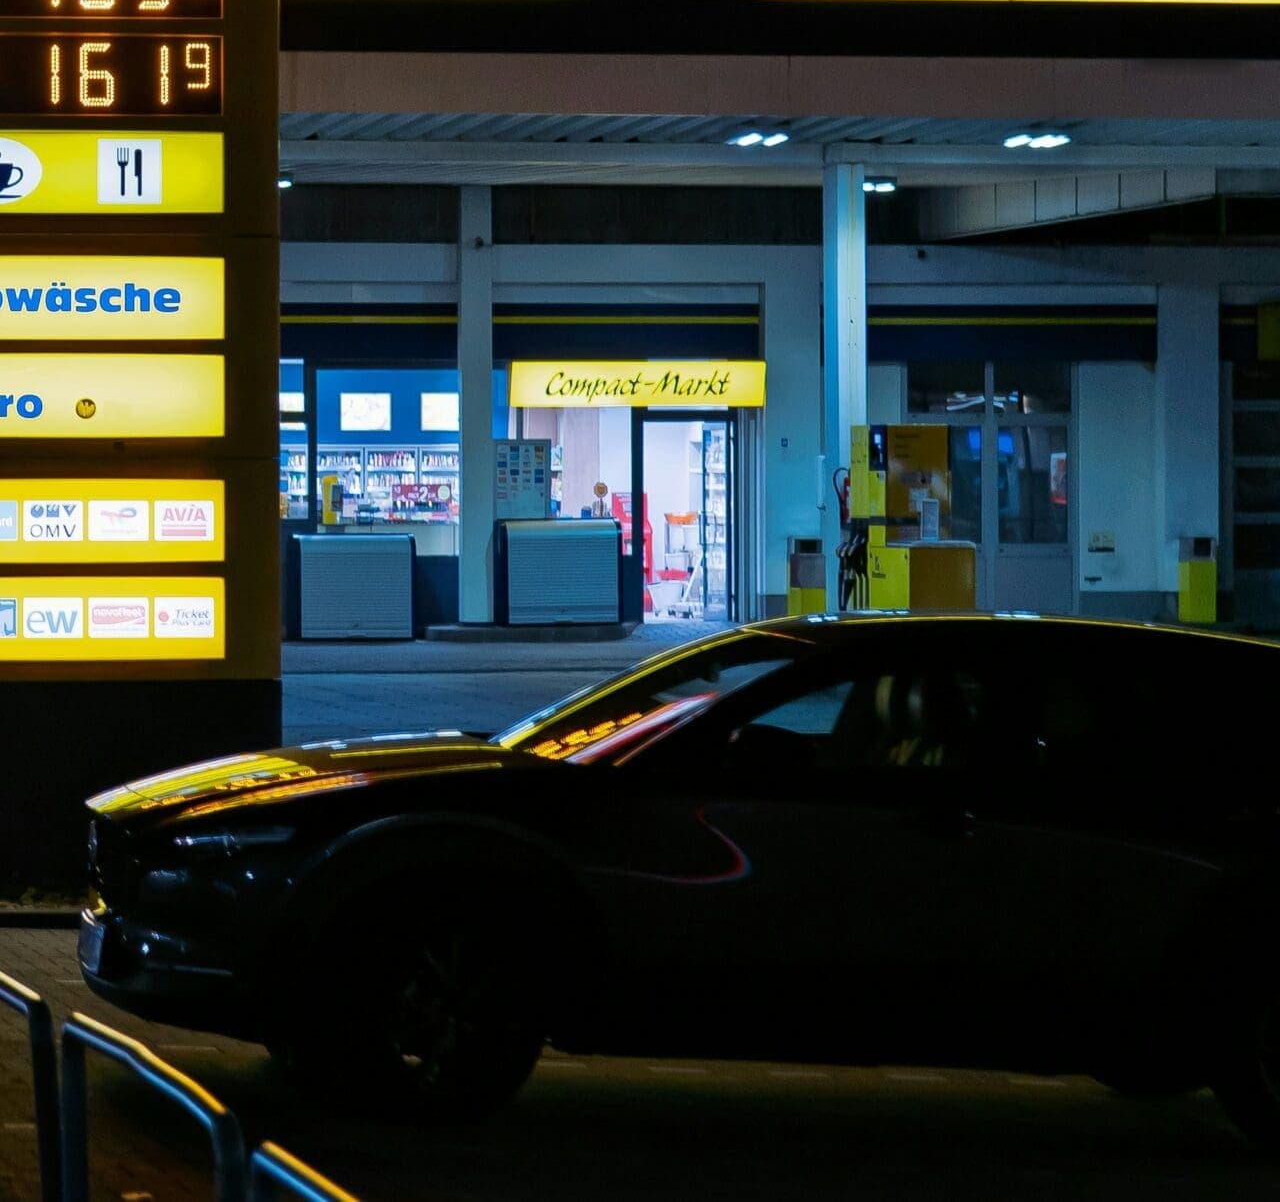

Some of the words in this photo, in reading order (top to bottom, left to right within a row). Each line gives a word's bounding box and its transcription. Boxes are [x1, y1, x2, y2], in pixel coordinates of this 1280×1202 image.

[545, 370, 731, 403] Compact-Markt
[30, 523, 76, 538] OMV
[175, 609, 210, 619] Ticket
